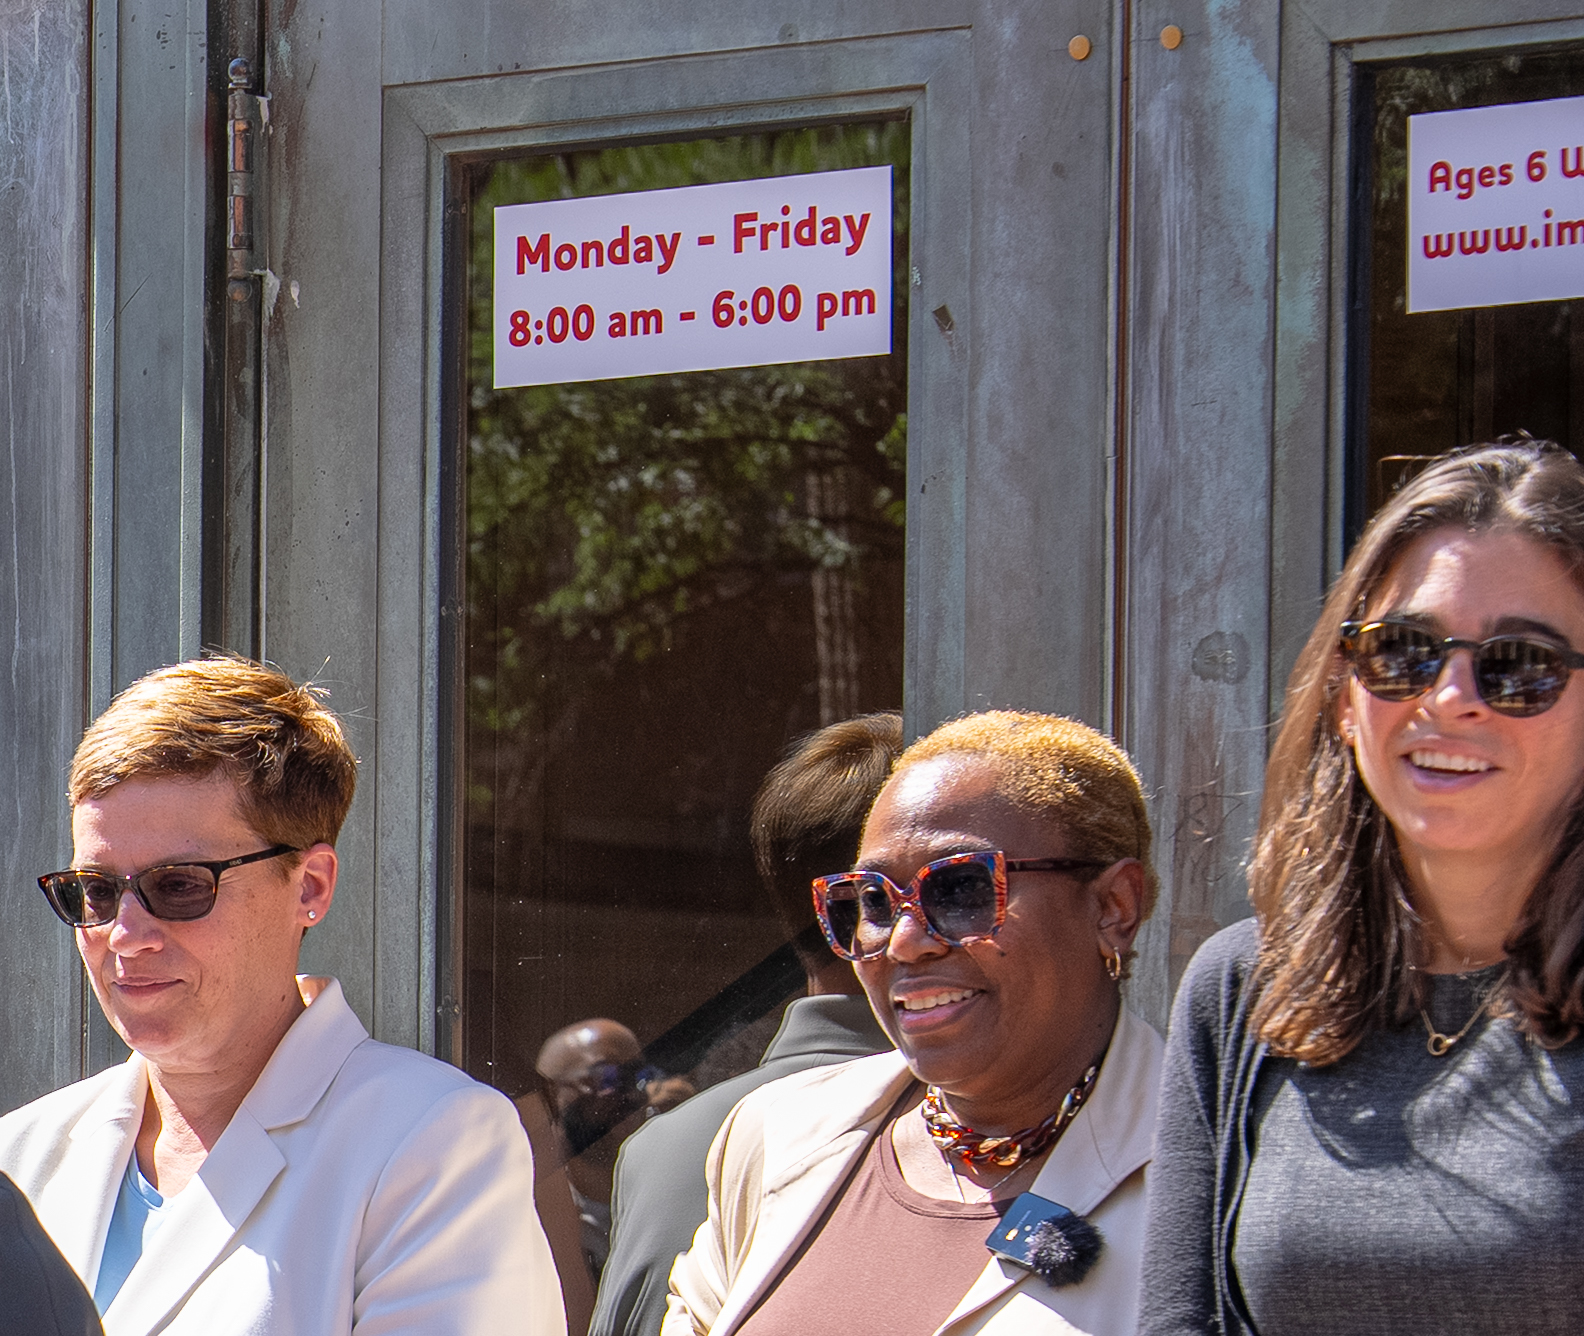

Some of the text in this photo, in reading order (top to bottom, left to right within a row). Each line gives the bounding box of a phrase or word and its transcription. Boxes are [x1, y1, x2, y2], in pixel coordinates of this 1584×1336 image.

[1428, 161, 1514, 199] Ages
[1527, 150, 1548, 182] 6
[516, 205, 871, 275] Monday - Friday
[509, 284, 876, 347] 8:00 am - 6:00 pm
